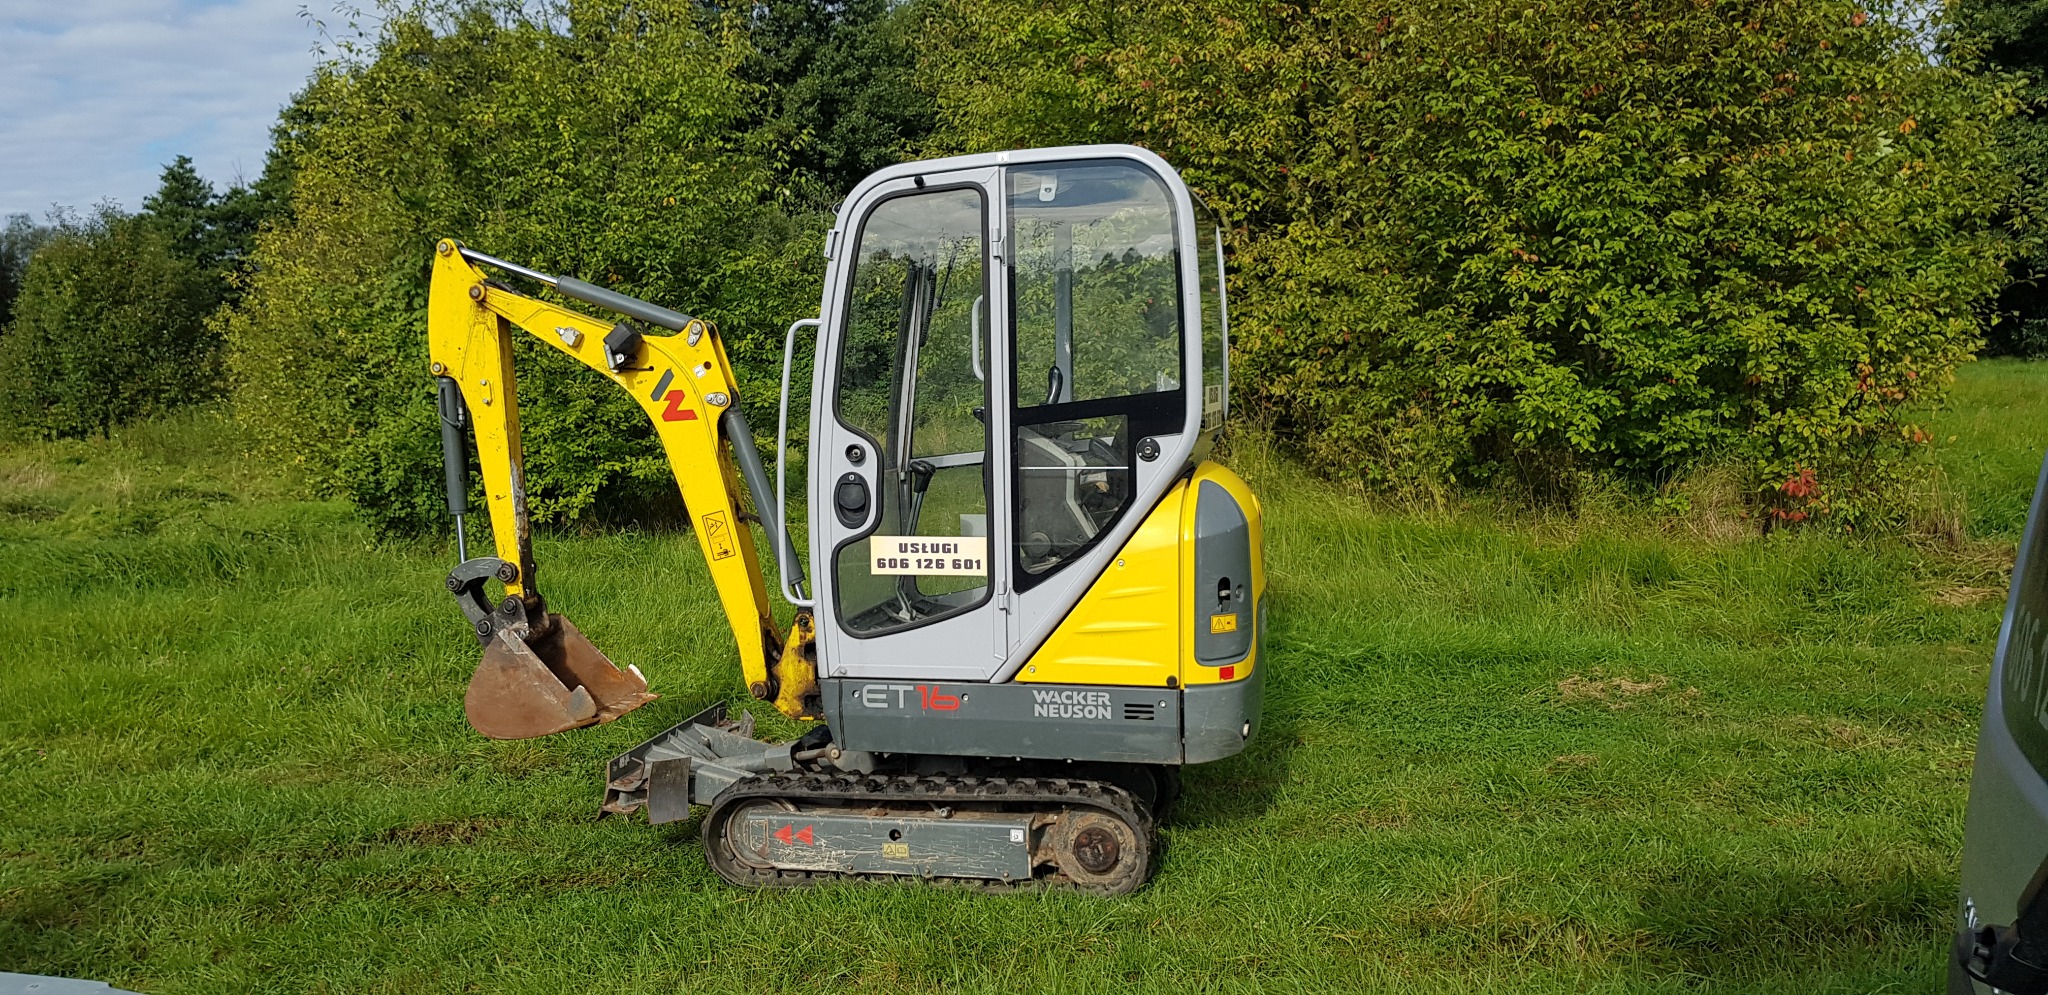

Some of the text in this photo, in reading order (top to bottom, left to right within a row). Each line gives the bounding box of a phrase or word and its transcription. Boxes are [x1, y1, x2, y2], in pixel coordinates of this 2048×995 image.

[898, 542, 958, 554] USŁUGI
[876, 558, 981, 570] 606 126 601
[862, 684, 960, 711] ET16
[1032, 690, 1112, 705] WACKER
[1034, 704, 1112, 720] NEUSON
